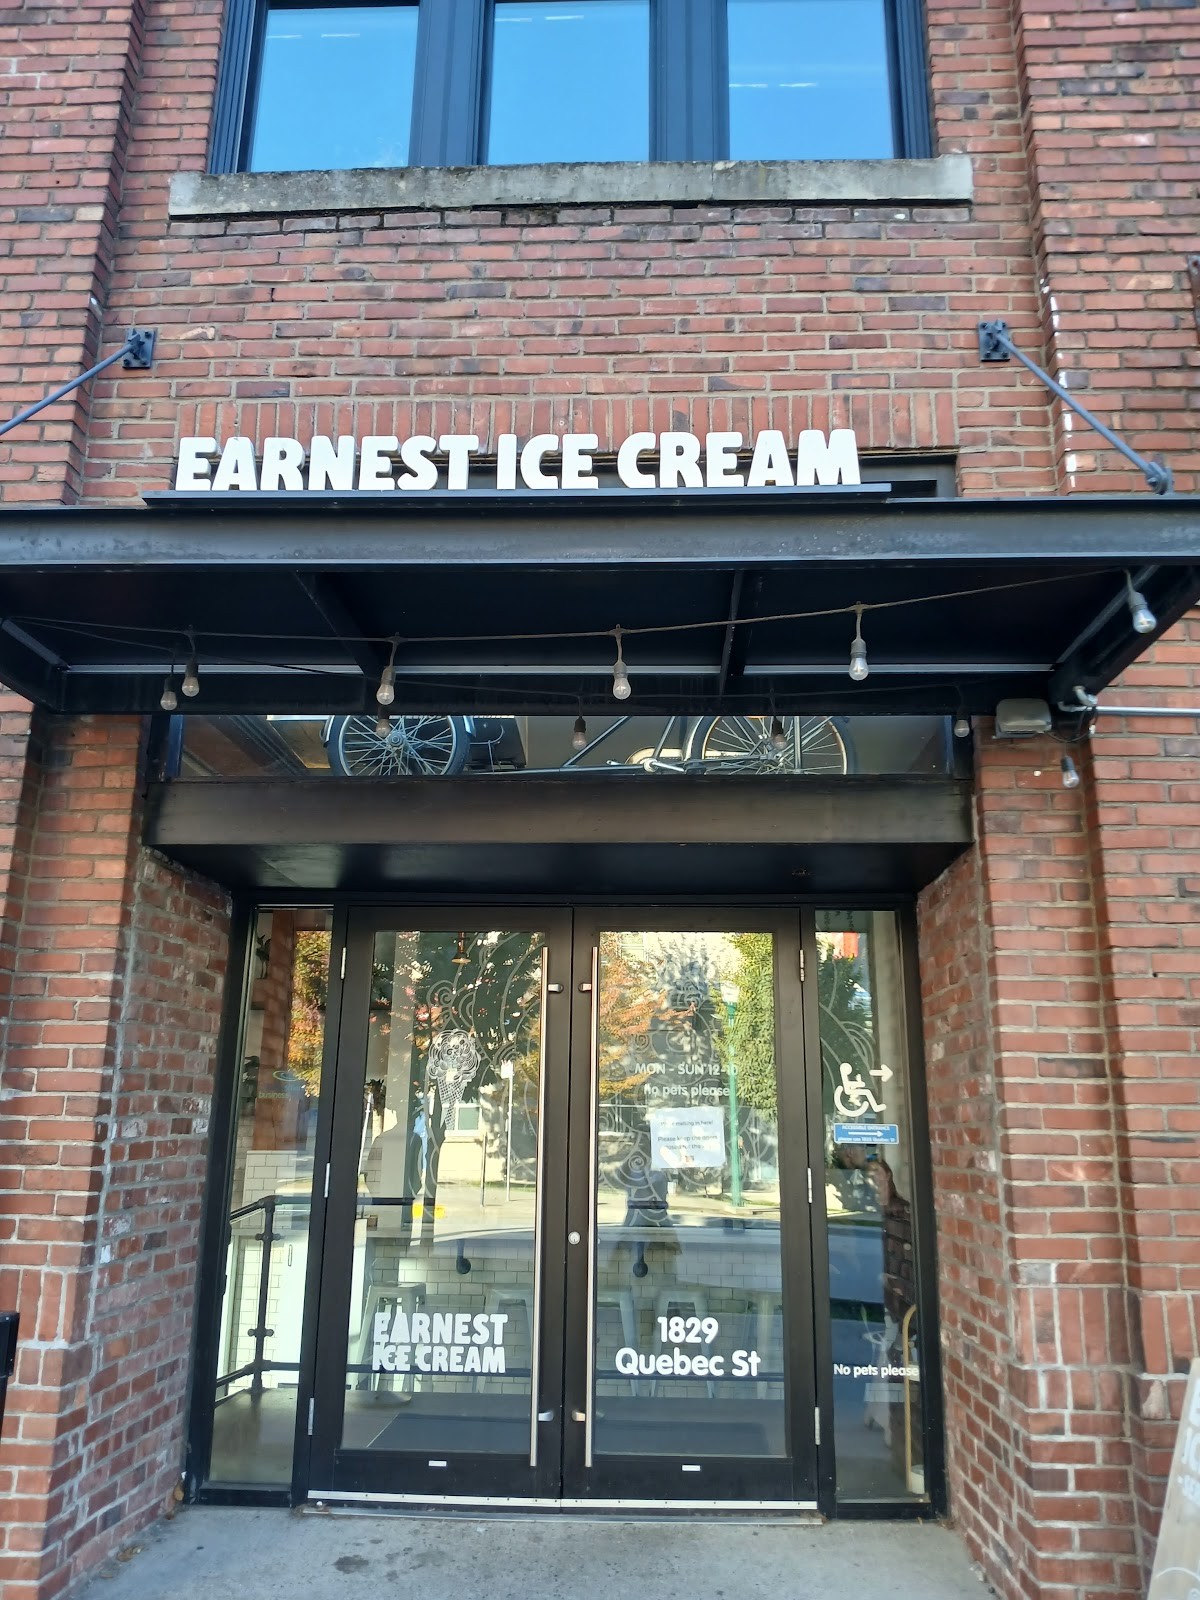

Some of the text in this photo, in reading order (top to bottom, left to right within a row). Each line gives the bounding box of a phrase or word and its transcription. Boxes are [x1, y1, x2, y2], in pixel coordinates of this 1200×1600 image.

[176, 429, 862, 492] EARNEST ICE CREAM
[635, 1063, 666, 1074] MON
[678, 1063, 704, 1075] SUN
[663, 1084, 688, 1097] pets
[691, 1084, 731, 1098] please
[372, 1312, 508, 1373] EARNEST ICE CREAM
[657, 1316, 719, 1344] 1829
[615, 1347, 761, 1377] Quebec St
[833, 1363, 920, 1379] No pets please
